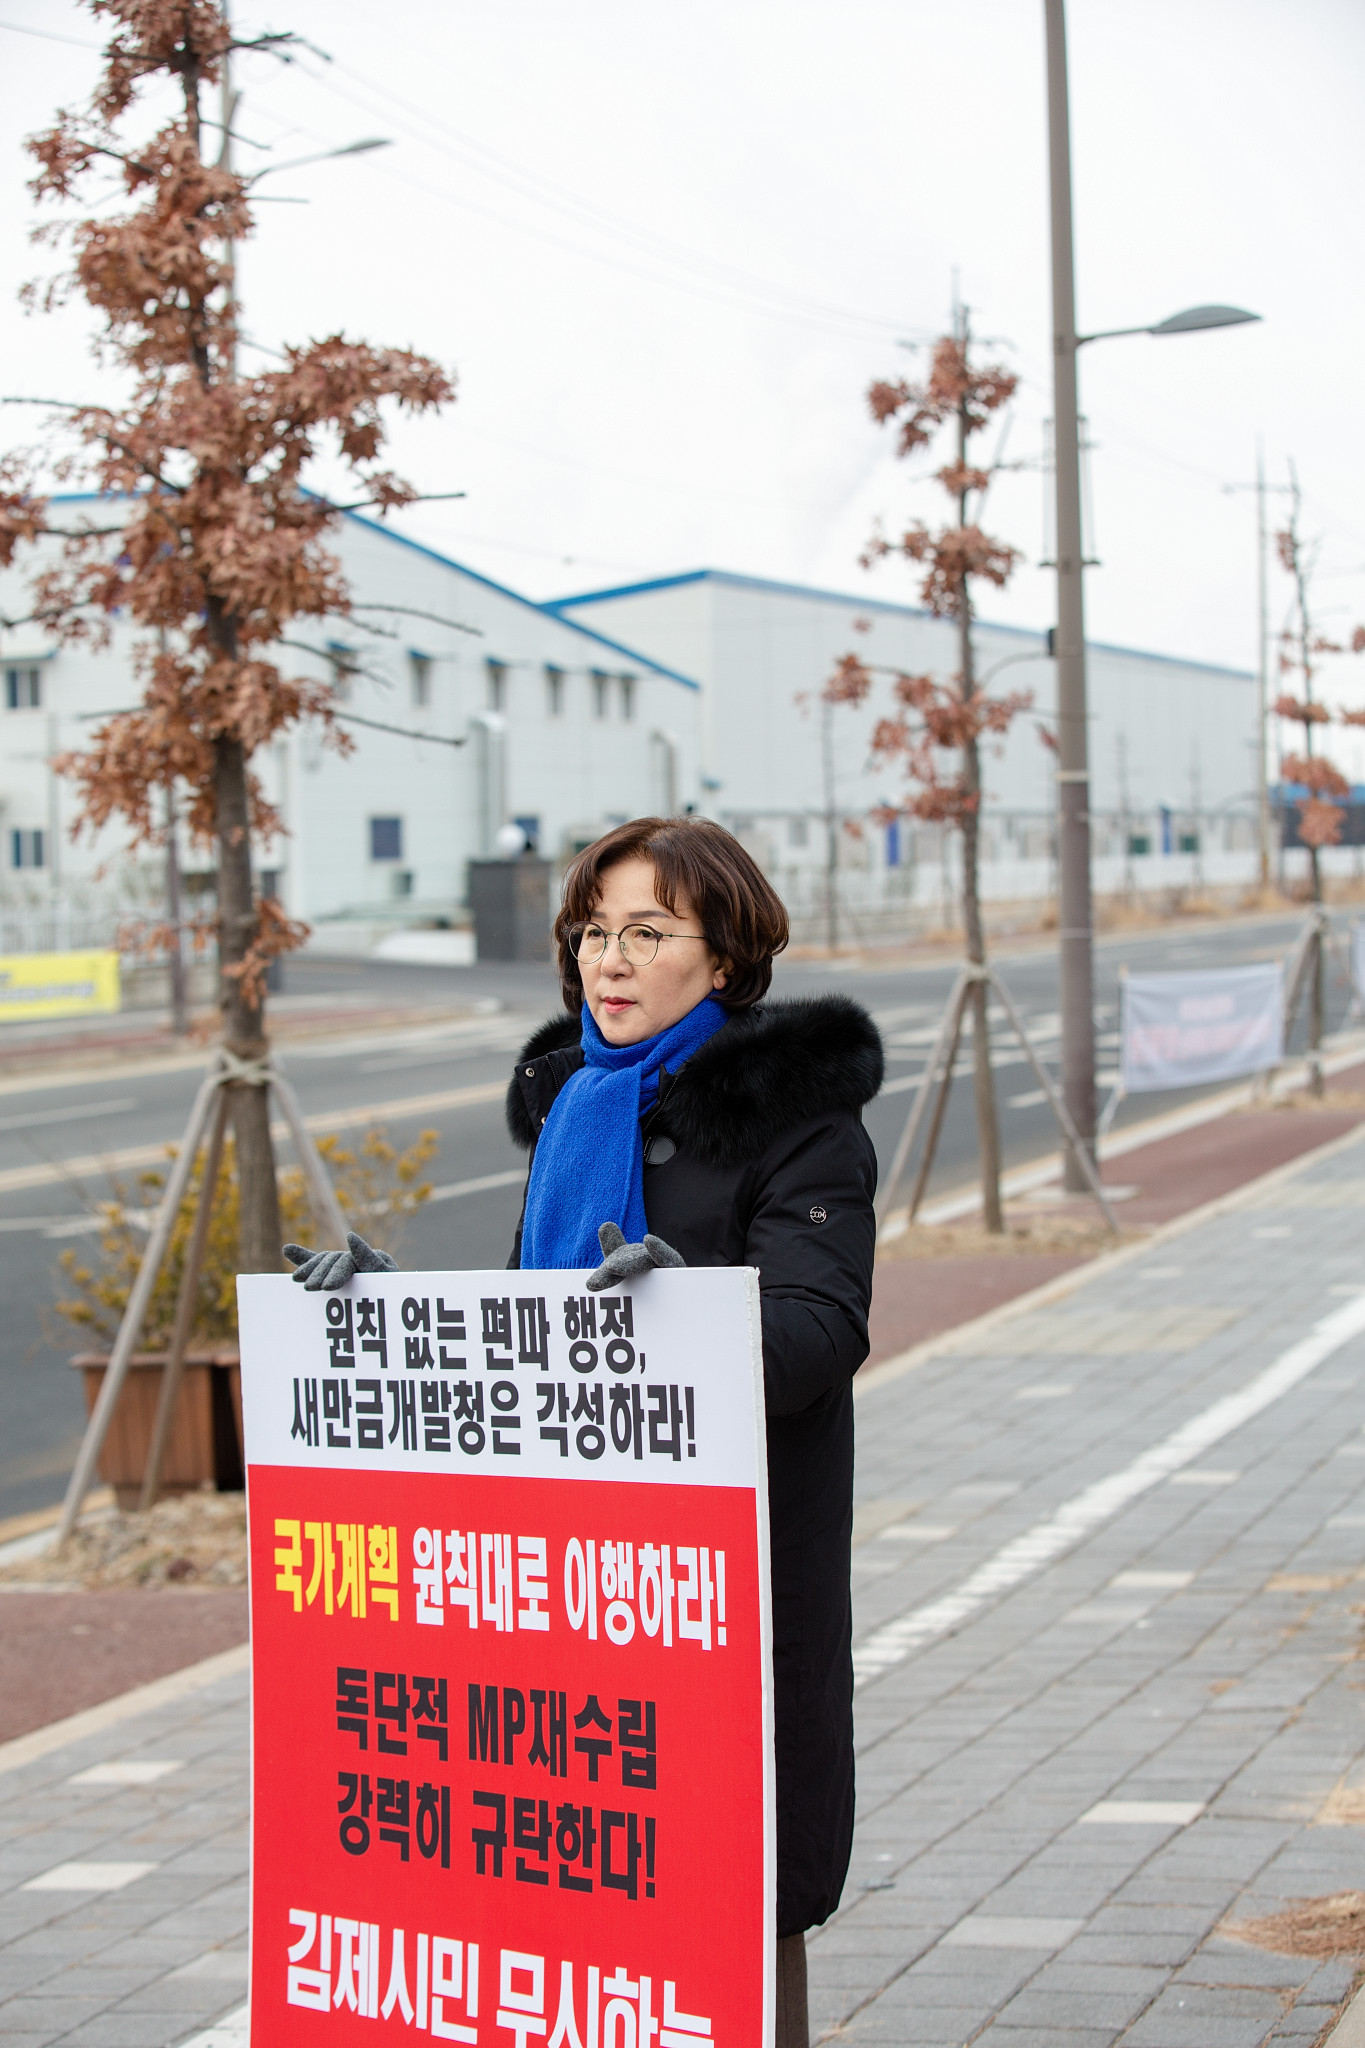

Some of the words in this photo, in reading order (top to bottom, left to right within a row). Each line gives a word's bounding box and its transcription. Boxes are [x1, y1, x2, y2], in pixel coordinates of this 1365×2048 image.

[326, 1298, 387, 1368] 원칙
[402, 1298, 466, 1369] 없는
[481, 1297, 550, 1371] 편파
[564, 1296, 645, 1374] 행정,
[291, 1378, 520, 1455] 새만금개발청은
[537, 1383, 696, 1461] 각성하라!
[275, 1519, 398, 1621] 국가계획
[413, 1527, 549, 1632] 원칙대로
[564, 1537, 726, 1650] 이행하라!
[336, 1667, 448, 1761] 독단적
[469, 1684, 656, 1790] MP재수립
[338, 1772, 450, 1868] 강력히
[472, 1790, 656, 1900] 규탄한다!
[287, 1909, 479, 2044] 김제시민
